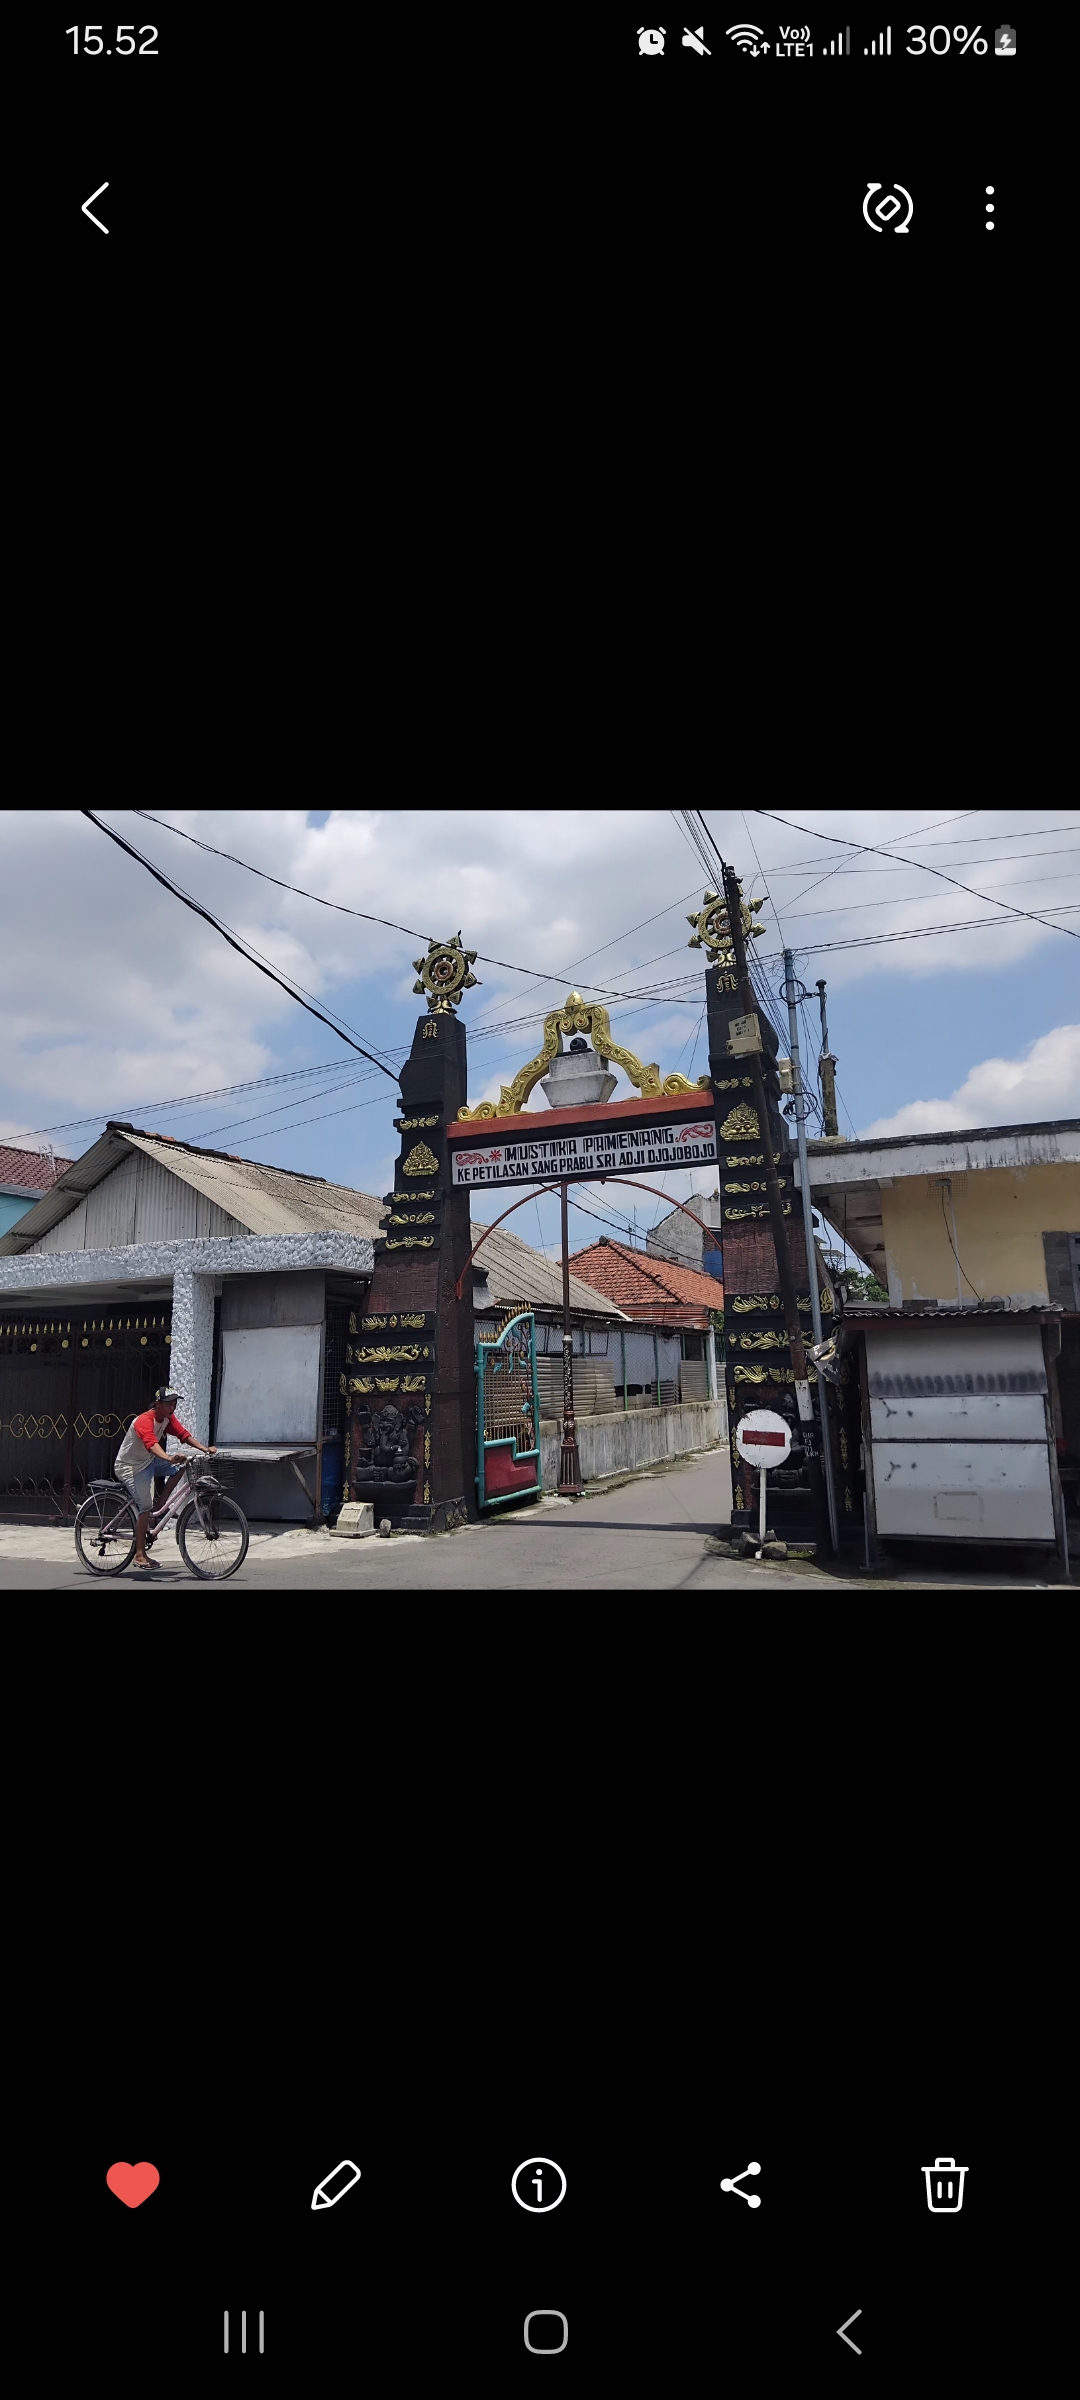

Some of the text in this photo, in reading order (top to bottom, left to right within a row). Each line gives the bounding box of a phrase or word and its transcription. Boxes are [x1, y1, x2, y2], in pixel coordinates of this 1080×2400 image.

[65, 24, 159, 56] 15.52
[775, 43, 814, 57] LTE1
[905, 24, 989, 56] 30%
[505, 1128, 675, 1162] MUSTIKA PAMENANG
[458, 1143, 715, 1182] KE PETILASAN SANG PRABU SRI ADJI DJOJOBOJO
